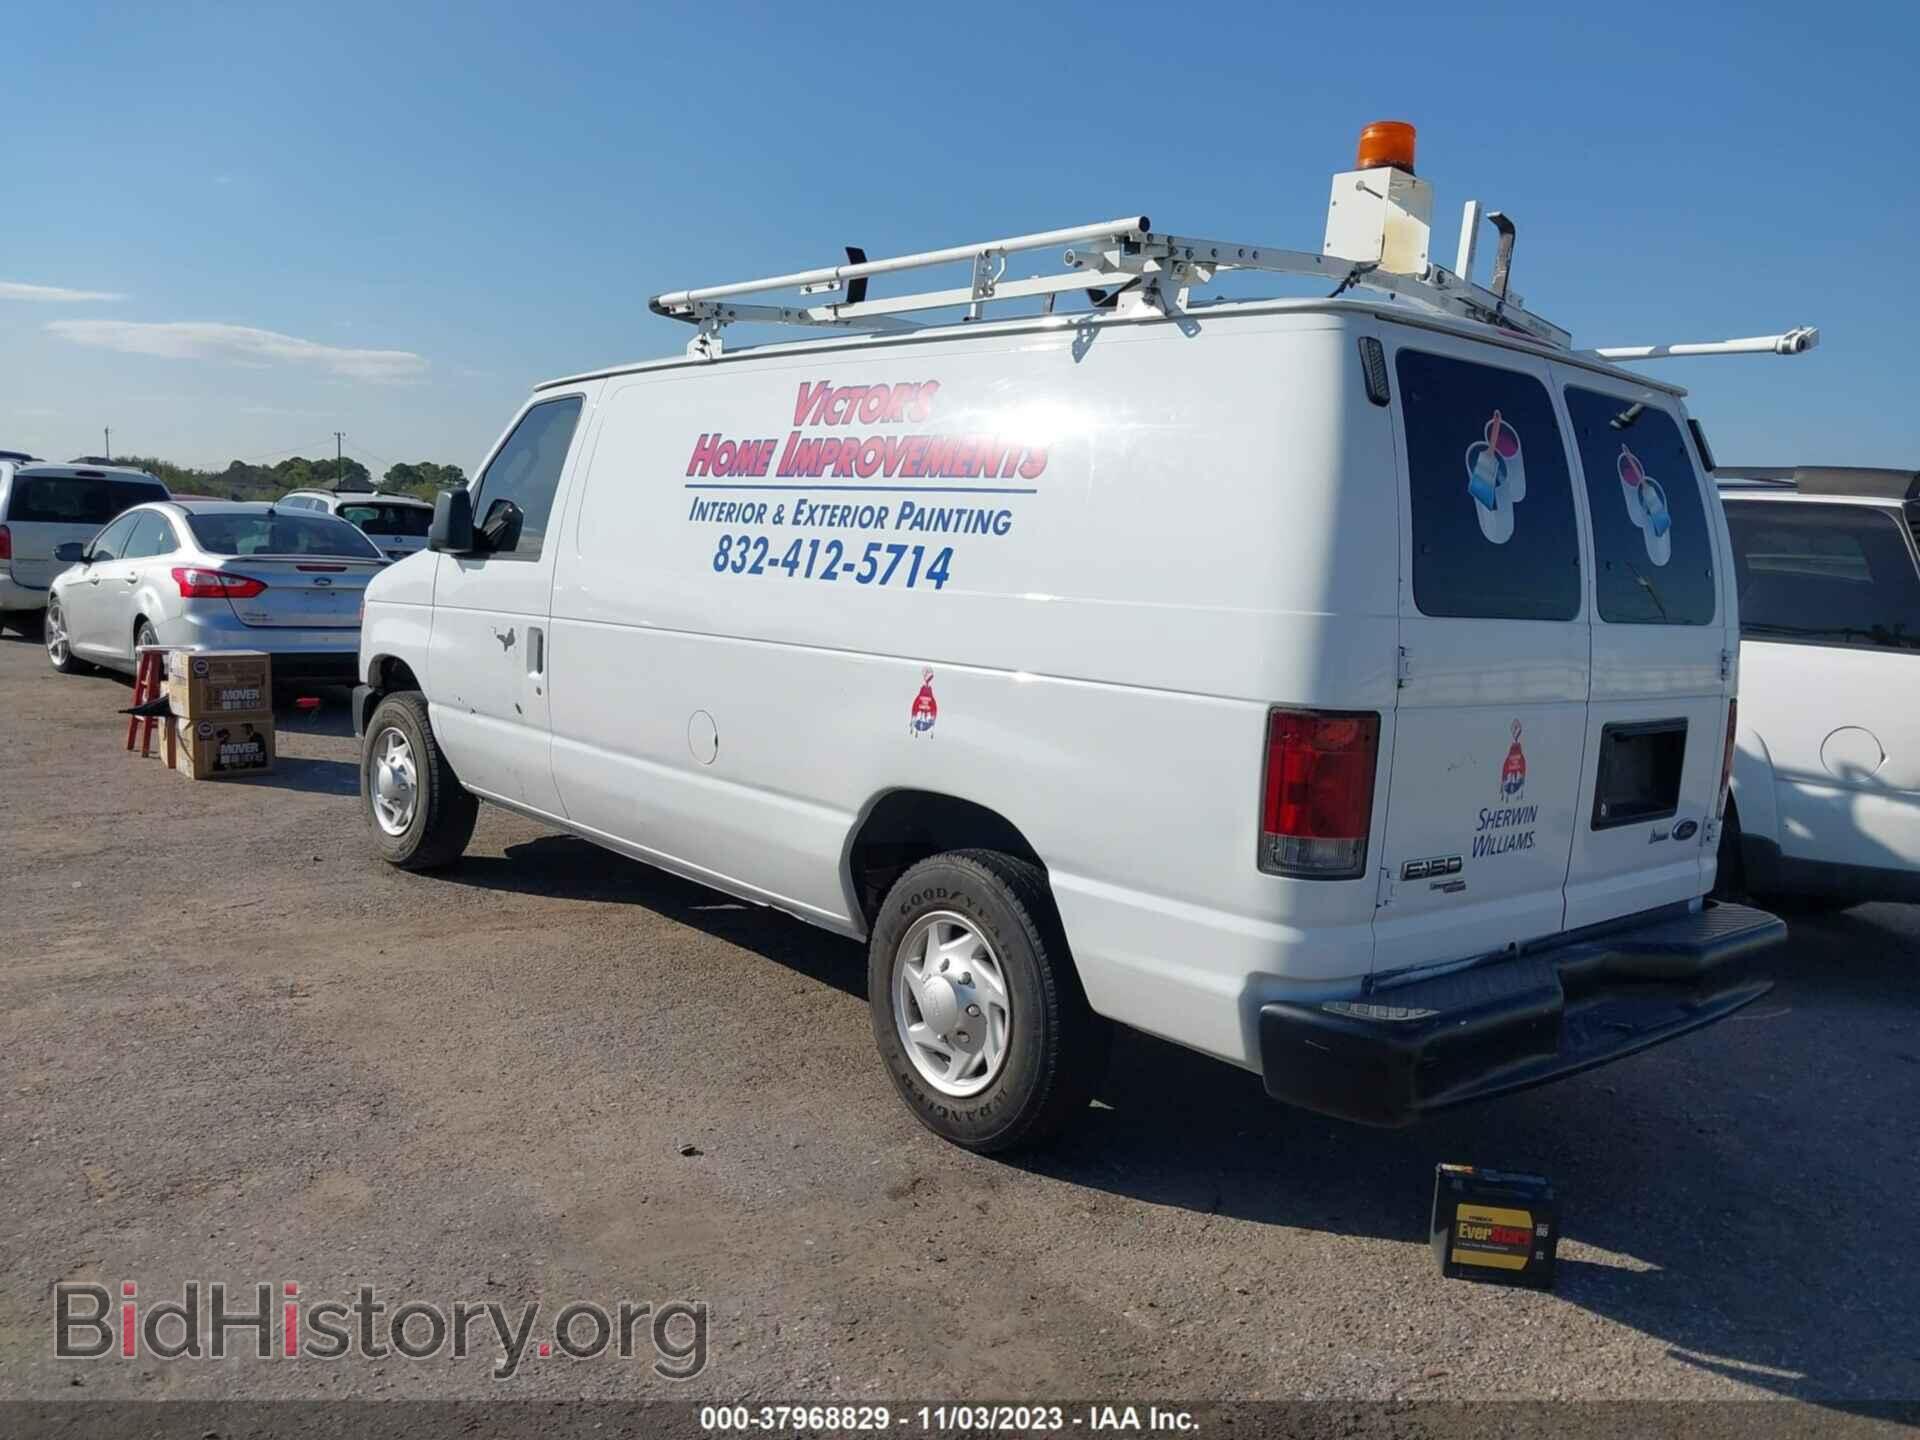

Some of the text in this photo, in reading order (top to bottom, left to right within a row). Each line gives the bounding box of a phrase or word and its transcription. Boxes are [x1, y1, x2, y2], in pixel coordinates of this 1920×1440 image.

[685, 433, 778, 477] HOME
[689, 497, 1013, 536] INTERIOR & EXTERIOR PAINTING
[712, 534, 954, 590] 832-412-5714
[222, 689, 259, 700] MOVER
[220, 743, 259, 754] MOVER
[1476, 806, 1538, 831] SHERWIN
